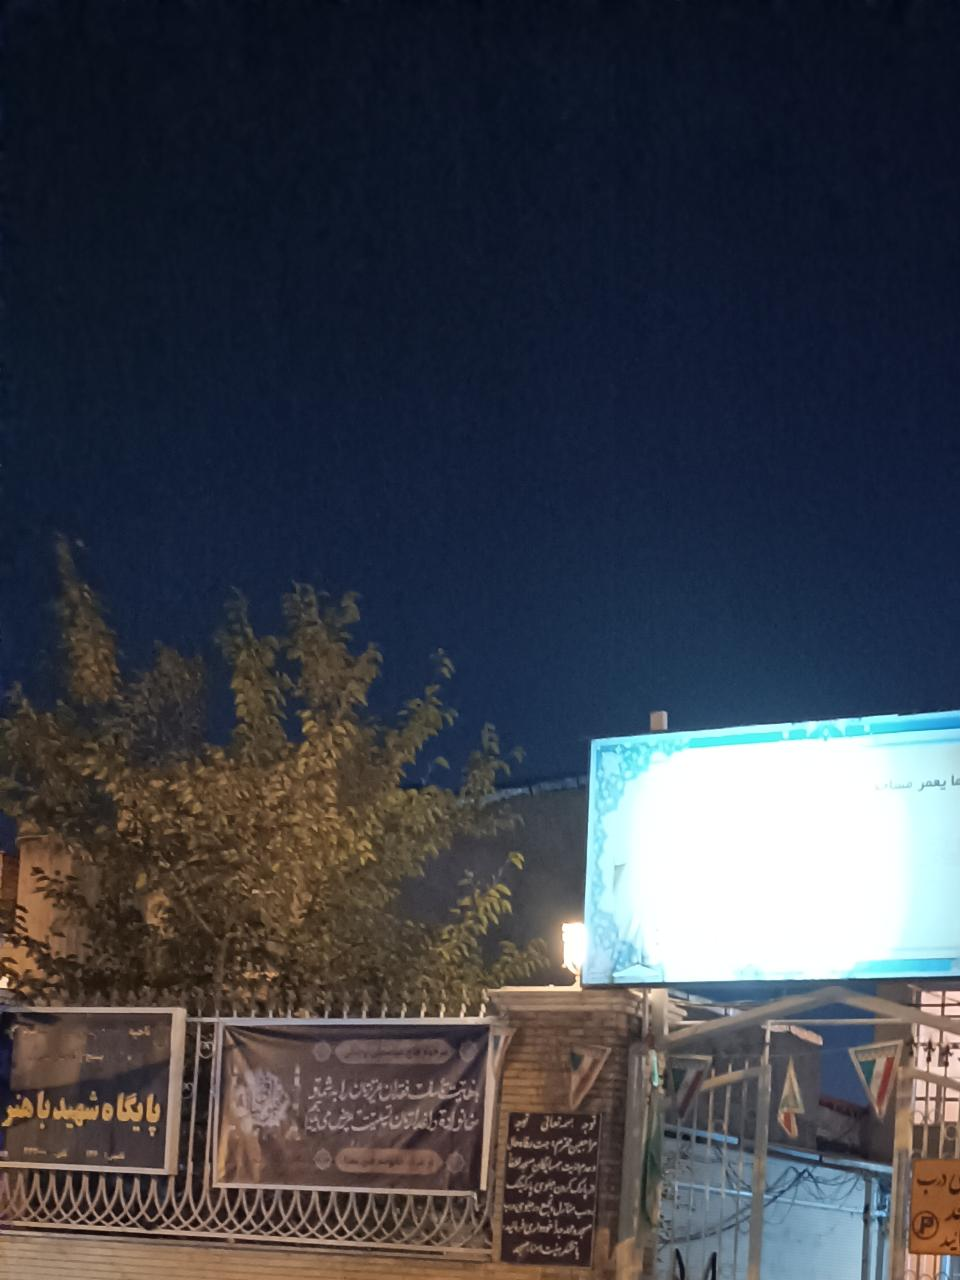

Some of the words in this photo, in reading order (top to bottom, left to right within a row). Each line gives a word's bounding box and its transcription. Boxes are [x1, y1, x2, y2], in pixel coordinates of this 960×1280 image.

[52, 1090, 99, 1129] شهید
[101, 1092, 161, 1137] پایگاه
[916, 1173, 947, 1195] درب
